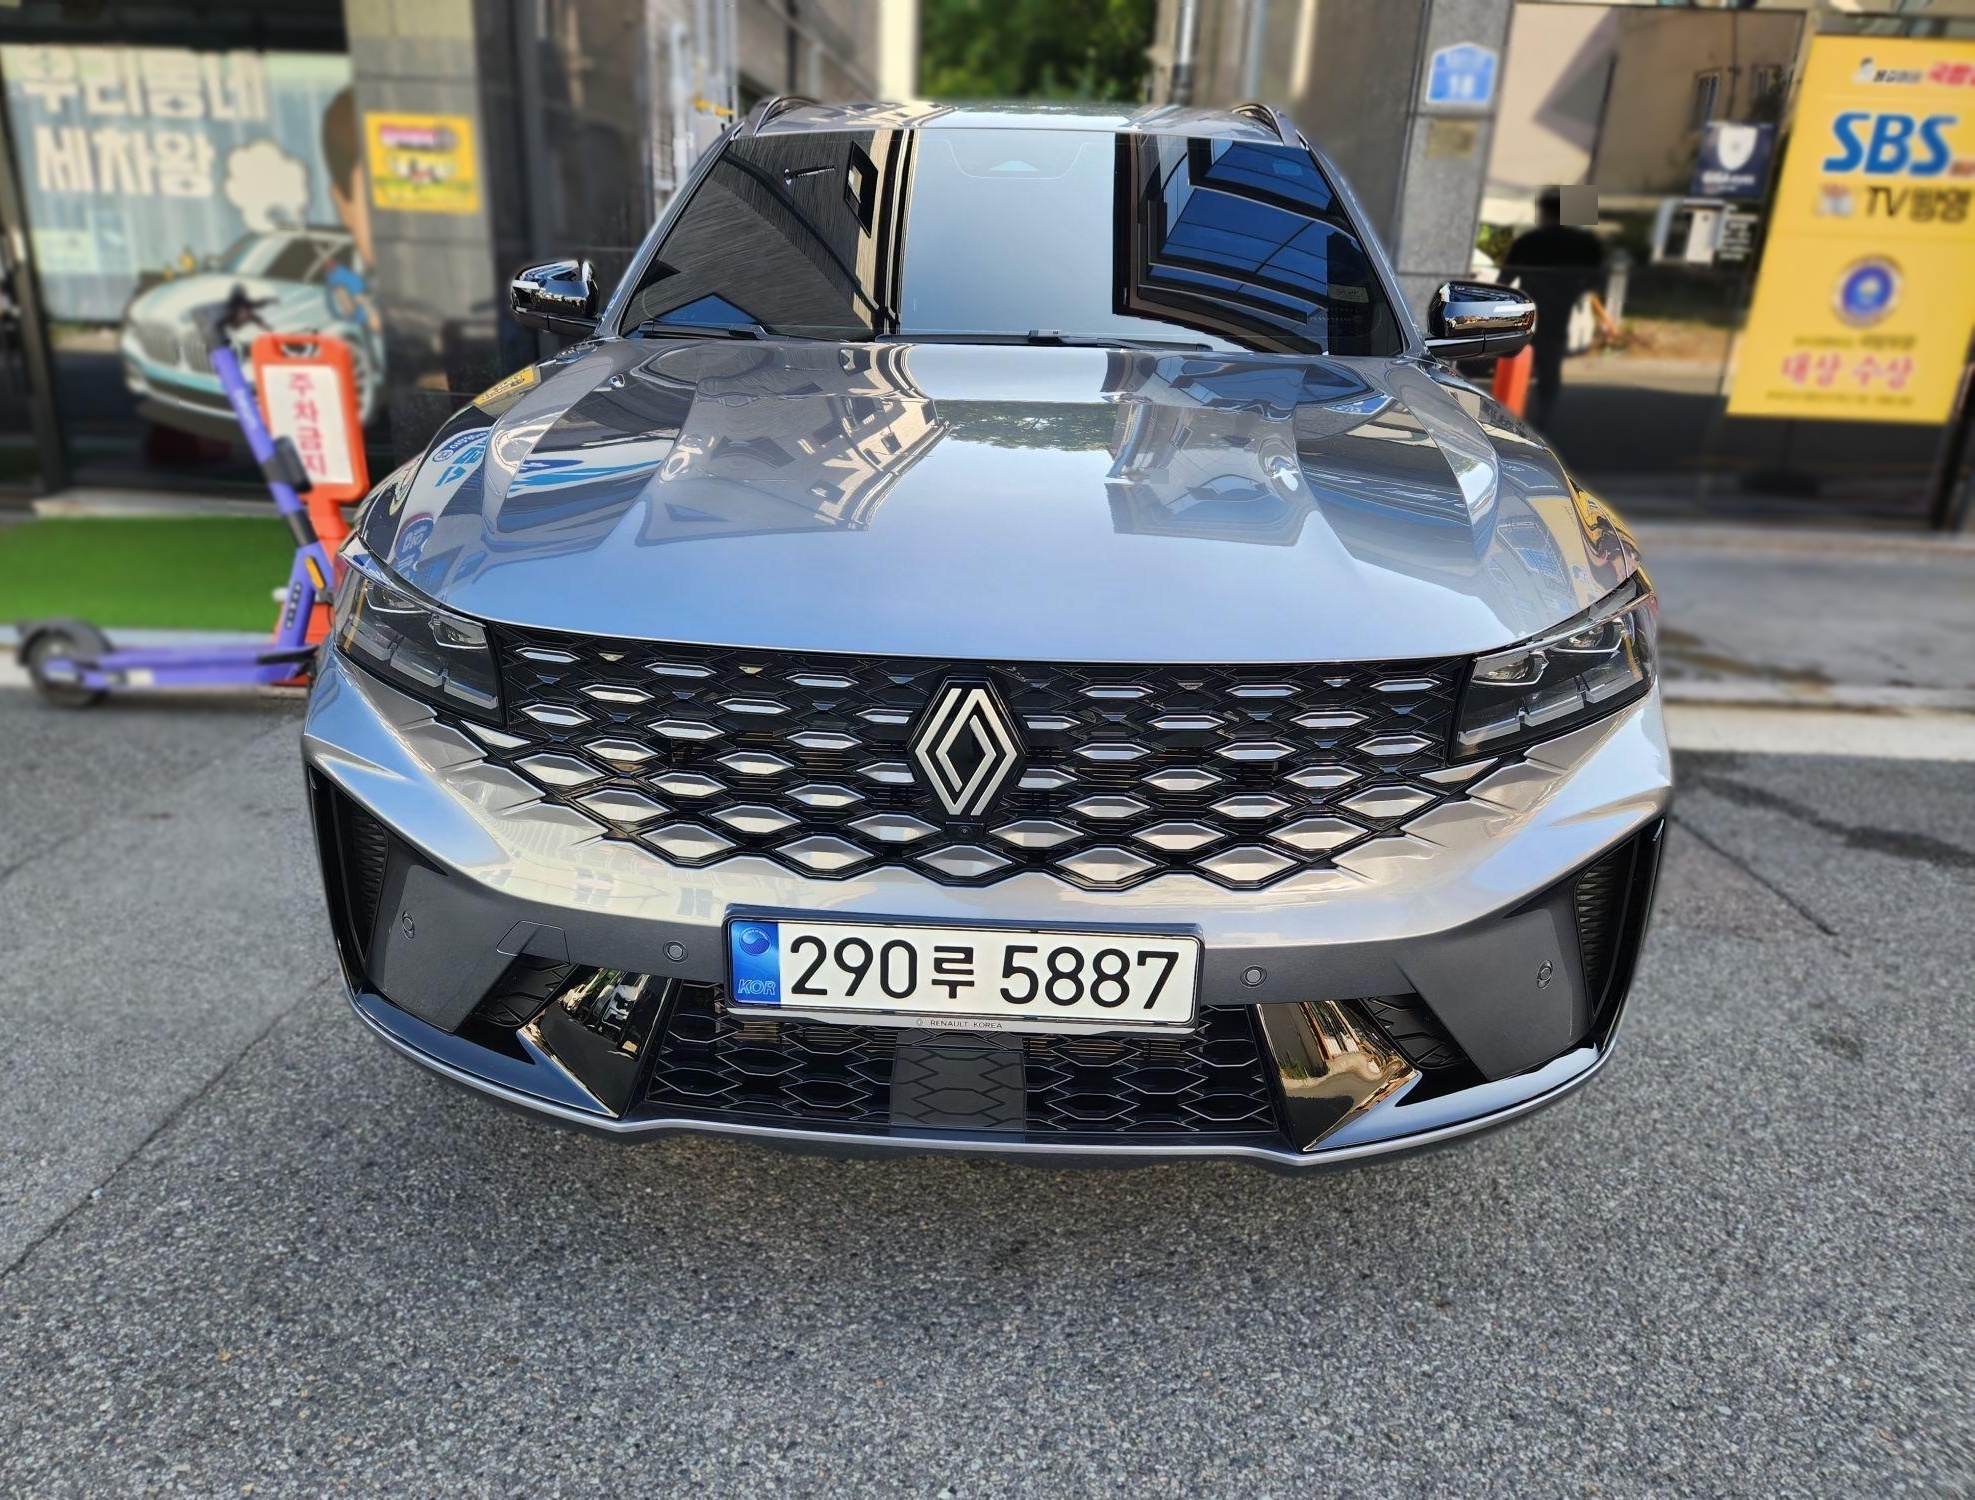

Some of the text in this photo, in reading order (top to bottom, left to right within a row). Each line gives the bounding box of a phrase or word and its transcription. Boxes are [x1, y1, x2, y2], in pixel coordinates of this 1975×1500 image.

[1822, 111, 1958, 176] SBS
[289, 372, 327, 476] 주차금지
[738, 978, 776, 996] KOR
[789, 934, 1180, 1010] 290루 5887
[930, 1019, 1003, 1029] RENAULT KOREA
